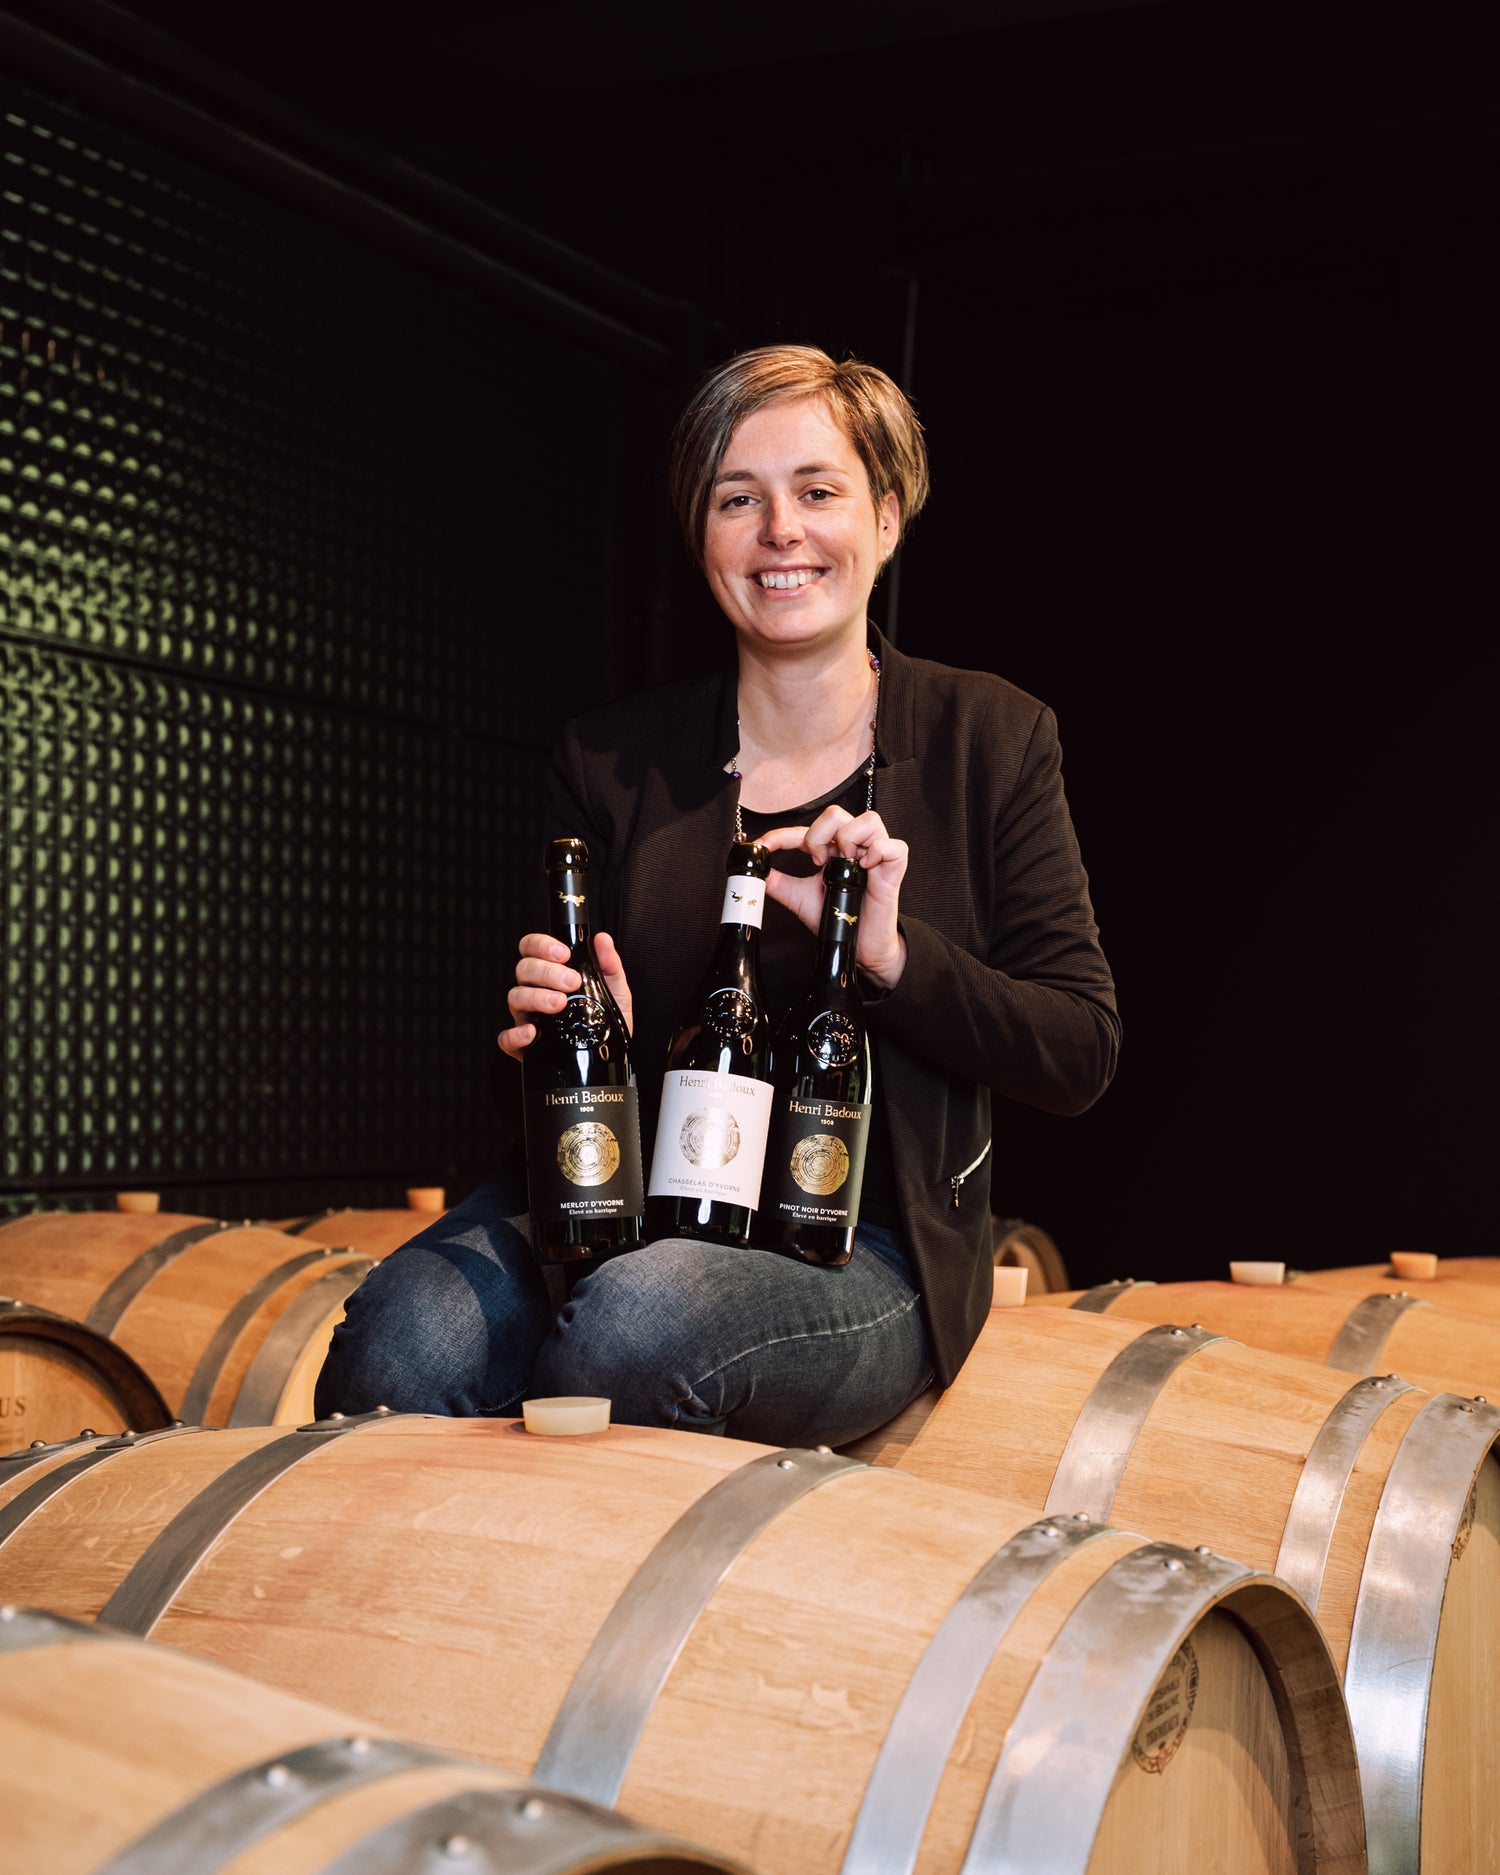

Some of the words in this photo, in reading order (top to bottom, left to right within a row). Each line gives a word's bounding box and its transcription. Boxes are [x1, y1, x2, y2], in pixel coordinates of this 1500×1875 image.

[545, 1092, 579, 1106] Henri
[582, 1090, 624, 1104] Badoux
[789, 1101, 821, 1116] Henri
[824, 1104, 862, 1120] Badoux
[668, 1177, 706, 1187] CHASSELAS
[560, 1201, 589, 1209] MERLOT
[590, 1199, 625, 1208] D'YVORNE
[779, 1202, 801, 1213] PINOT
[801, 1206, 819, 1214] NOIR
[820, 1208, 849, 1217] D'YVORNE
